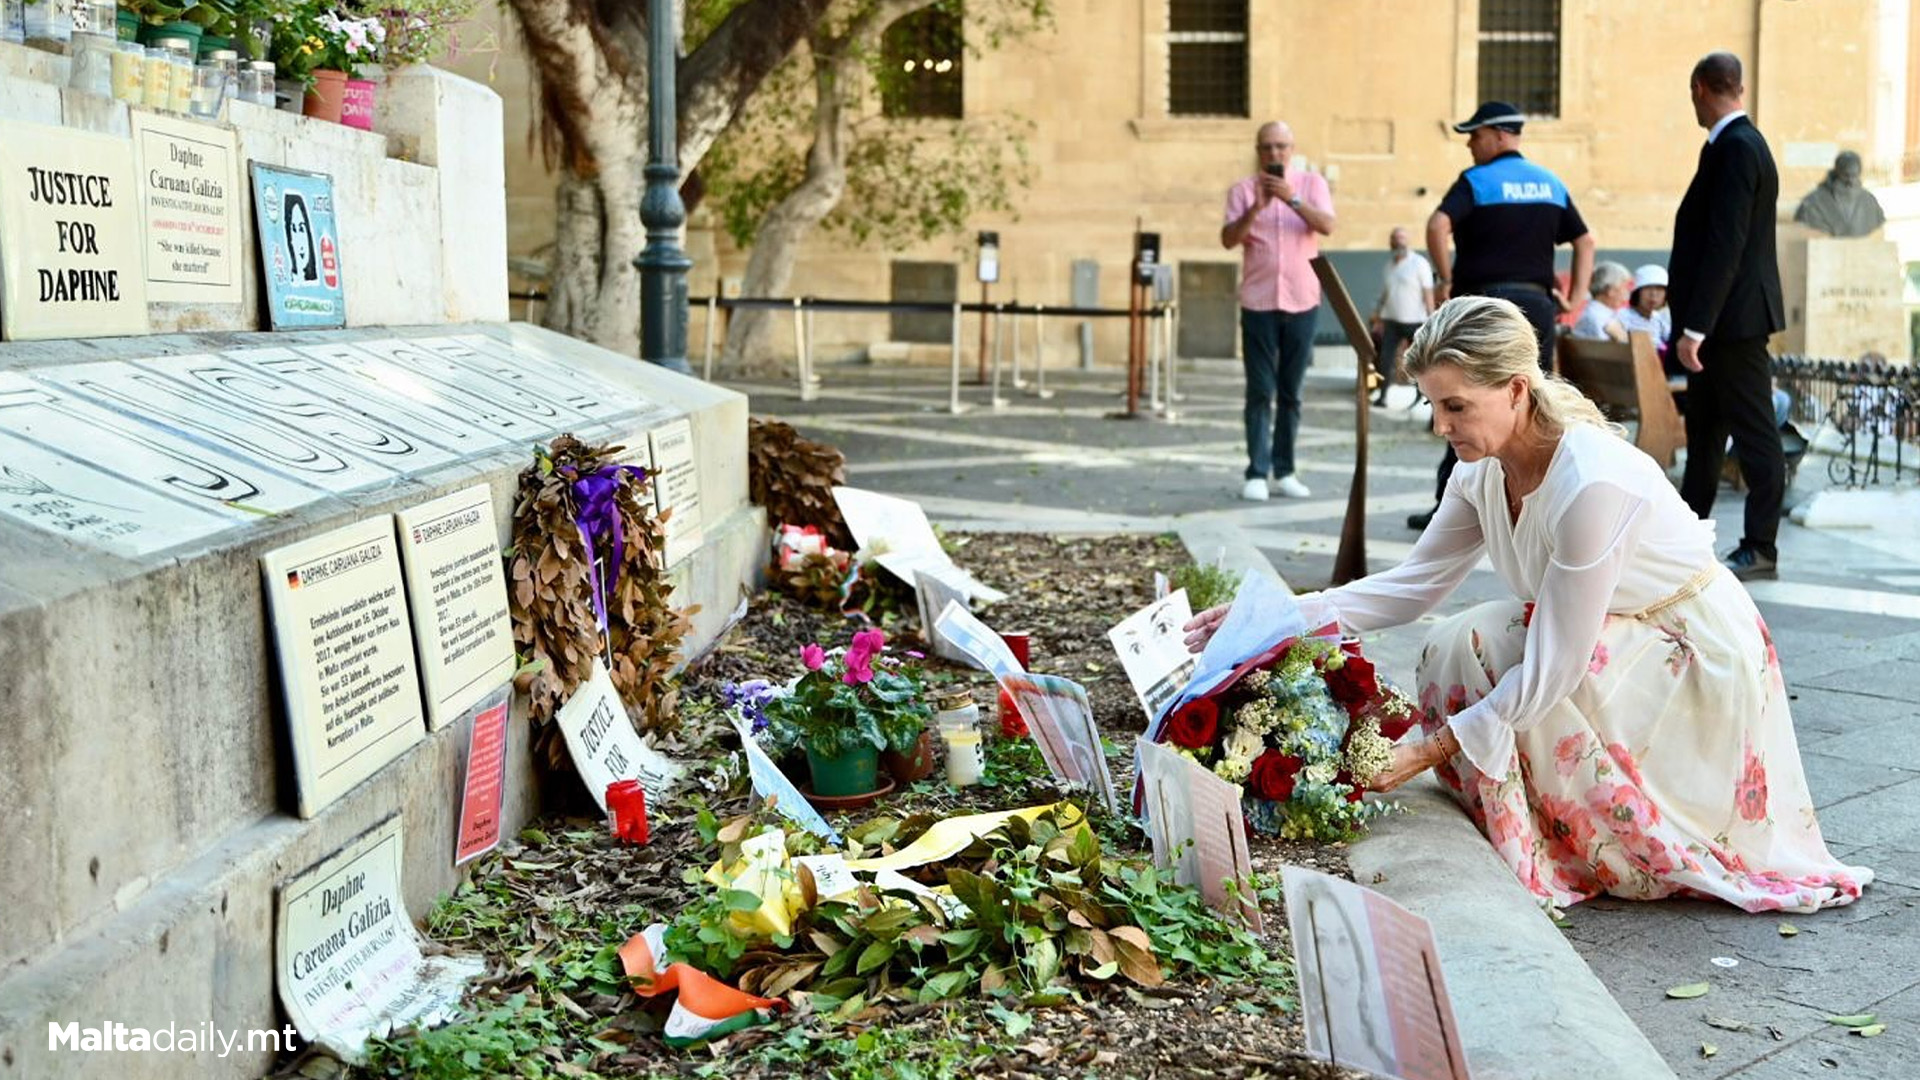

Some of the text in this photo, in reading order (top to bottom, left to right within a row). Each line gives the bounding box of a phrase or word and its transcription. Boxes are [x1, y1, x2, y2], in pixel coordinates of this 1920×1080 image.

[170, 142, 204, 169] Daphne
[27, 166, 112, 208] JUSTICE
[150, 169, 223, 199] Caruana Galizia
[56, 220, 99, 256] FOR
[38, 268, 120, 302] DAPHNE
[301, 544, 382, 584] DAPHNE CARUANA GALIZIA
[340, 674, 348, 687] 53
[580, 695, 614, 759] JUSTICE
[604, 744, 629, 781] FOR
[322, 872, 366, 916] Daphne
[294, 895, 392, 981] Caruana Galizia
[304, 957, 362, 1006] INVESTIGATIVE
[361, 925, 396, 963] JOURNALIST
